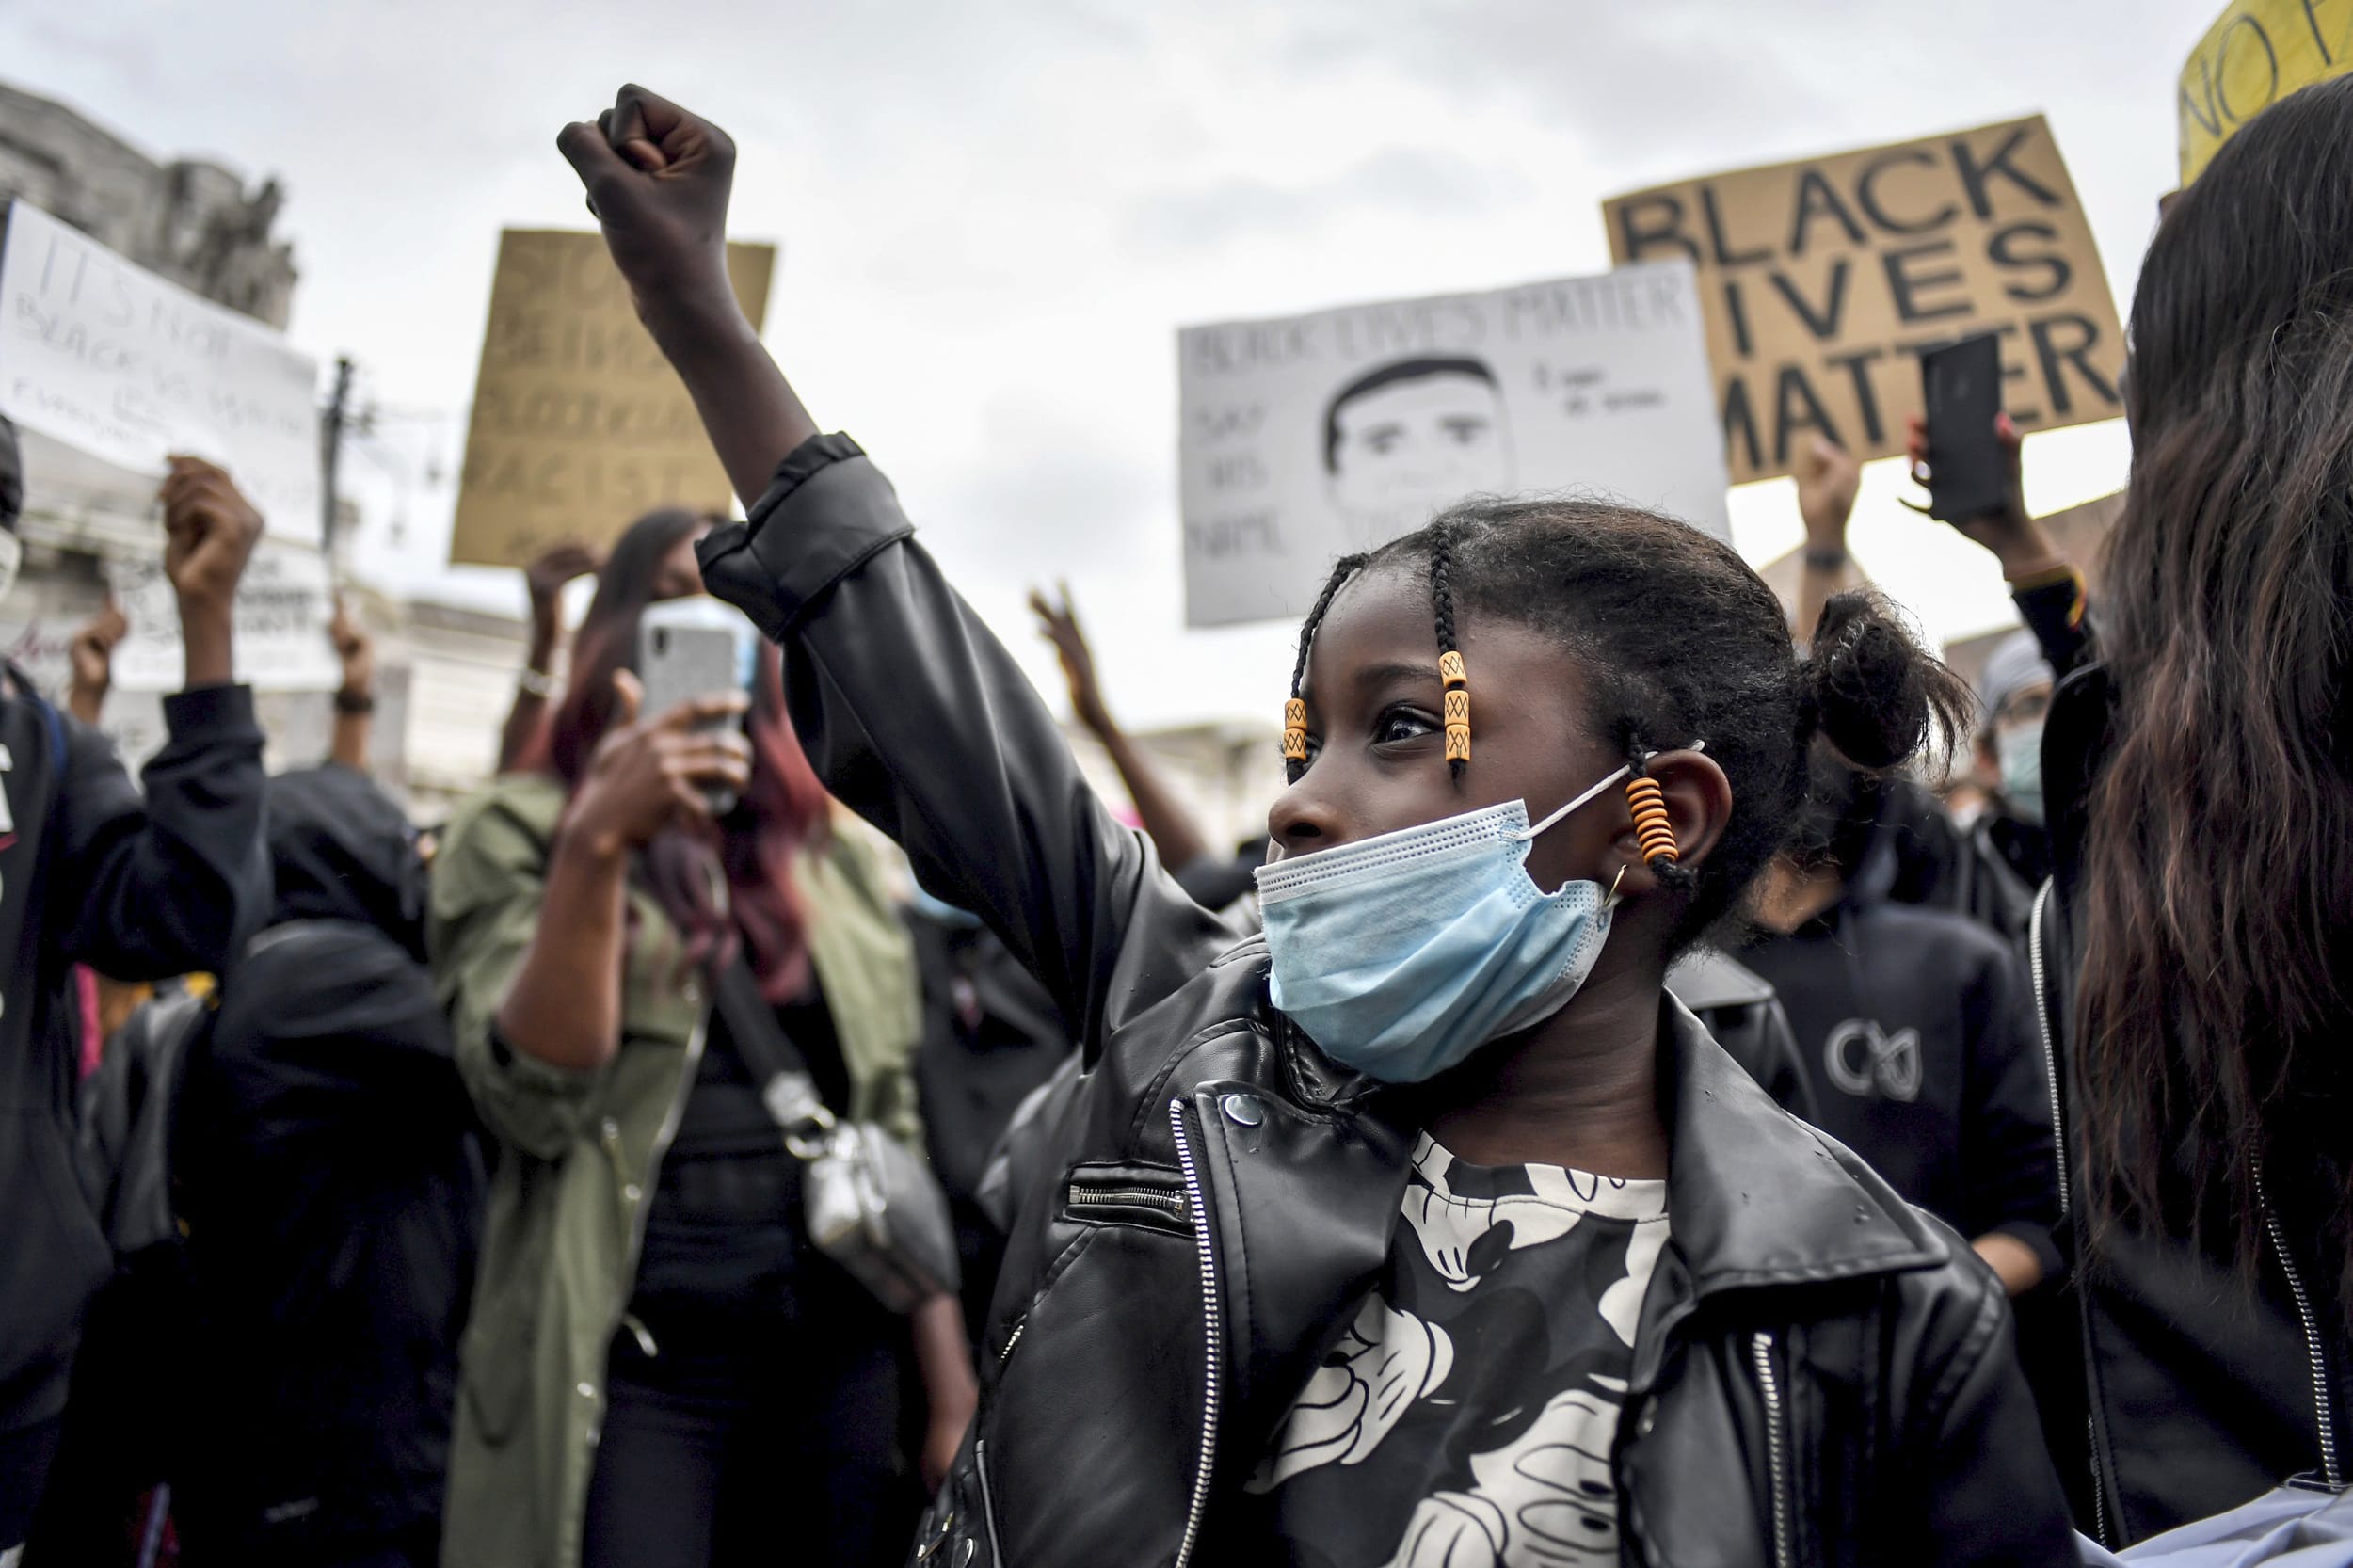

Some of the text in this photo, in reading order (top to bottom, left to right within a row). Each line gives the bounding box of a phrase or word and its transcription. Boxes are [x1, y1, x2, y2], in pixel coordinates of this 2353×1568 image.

[1617, 128, 2063, 269] BLACK
[1503, 273, 1687, 343] MATTER
[1722, 222, 2074, 360] IVES
